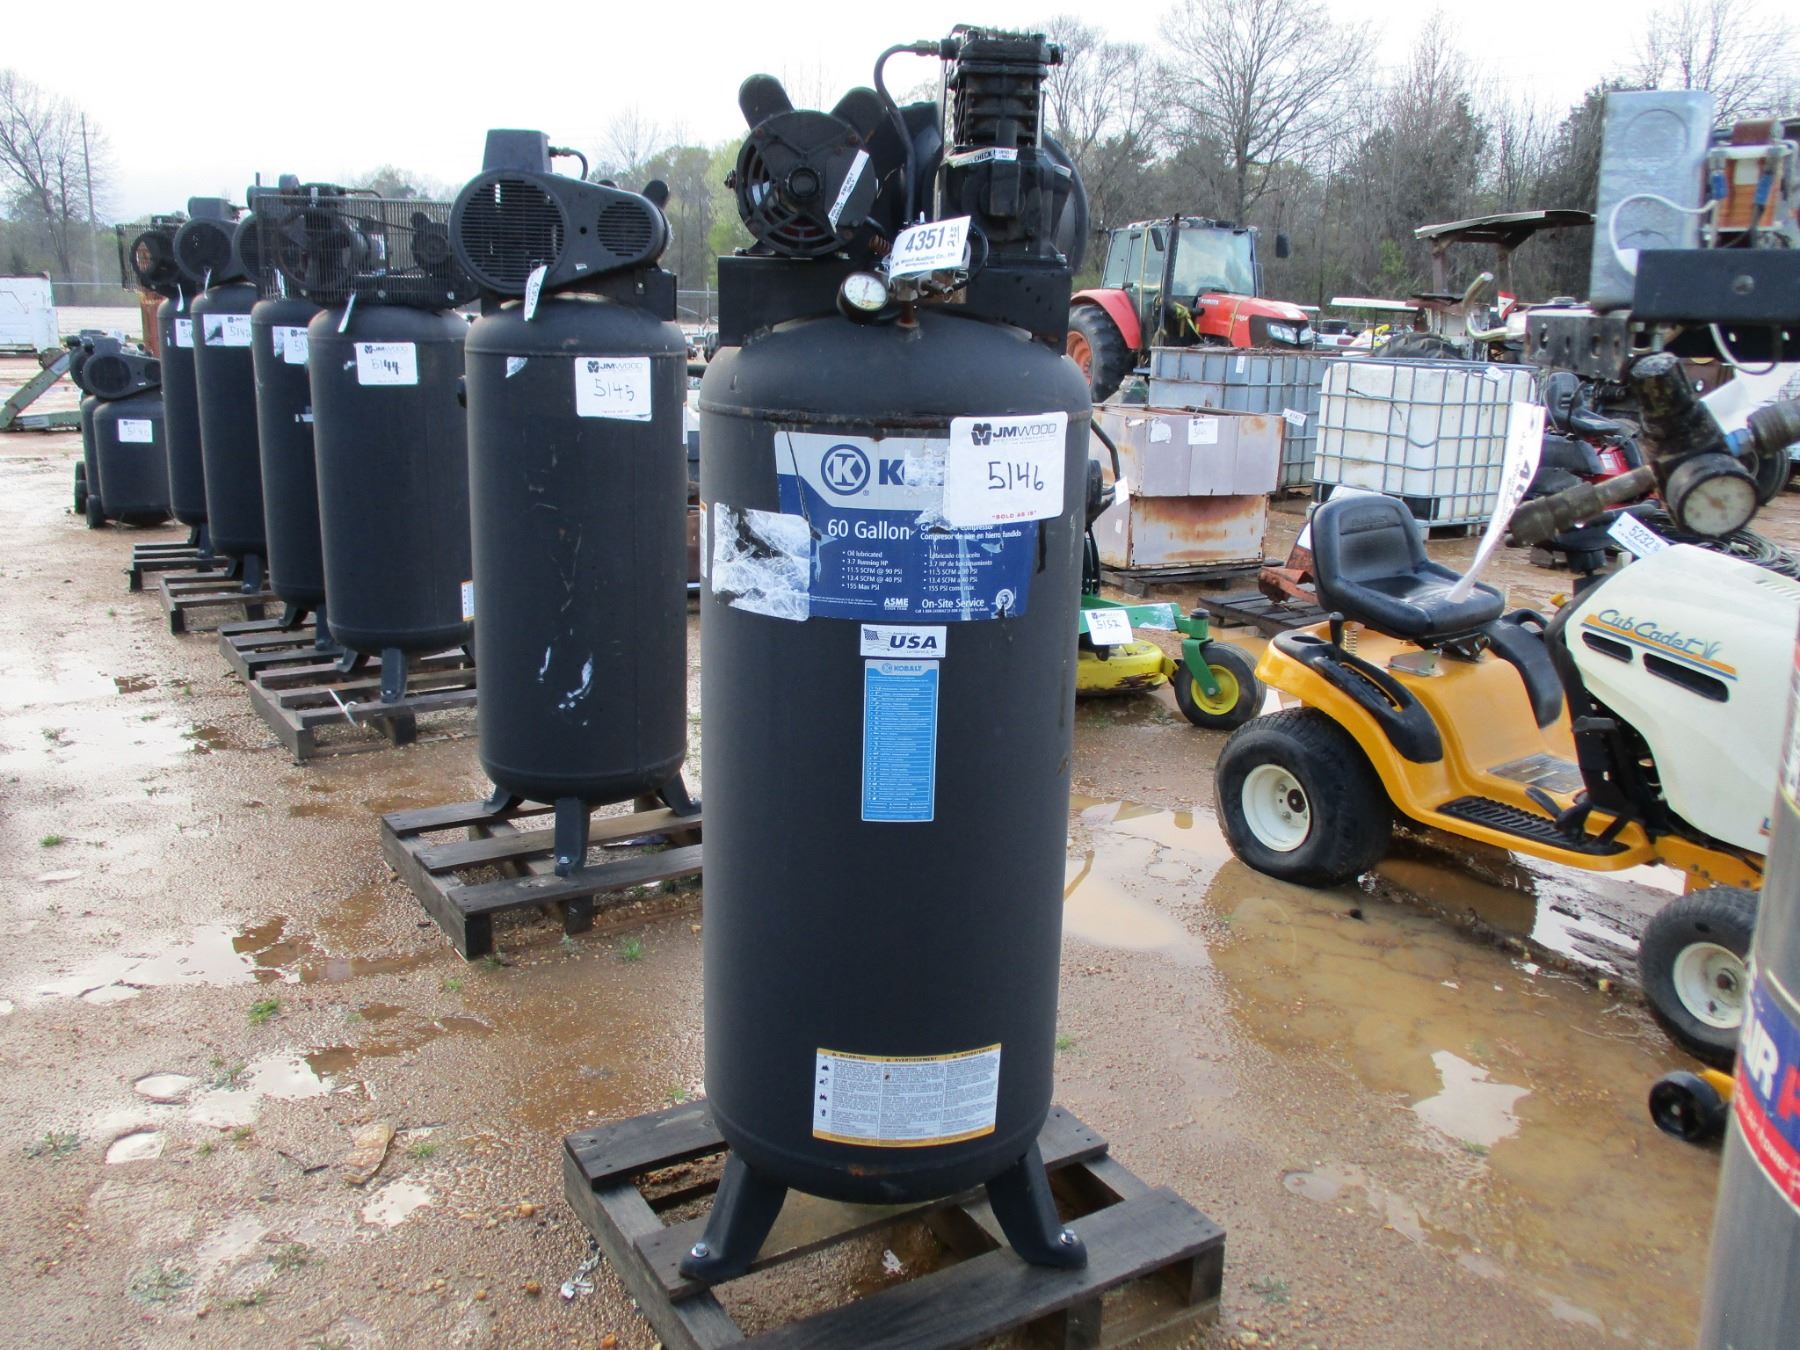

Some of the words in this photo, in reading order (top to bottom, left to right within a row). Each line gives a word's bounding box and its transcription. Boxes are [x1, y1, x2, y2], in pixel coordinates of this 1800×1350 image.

[905, 225, 945, 253] 4351
[988, 461, 1044, 491] 5146
[827, 519, 849, 538] 60
[854, 520, 910, 541] Gallon
[1629, 525, 1656, 549] 5232
[856, 550, 883, 558] lubricated
[857, 559, 880, 567] Running
[884, 597, 909, 607] ASME
[921, 598, 954, 608] On-Site
[955, 597, 985, 608] Service
[1598, 609, 1634, 632] Cub
[1634, 622, 1704, 655] Cadet
[890, 635, 938, 650] USA
